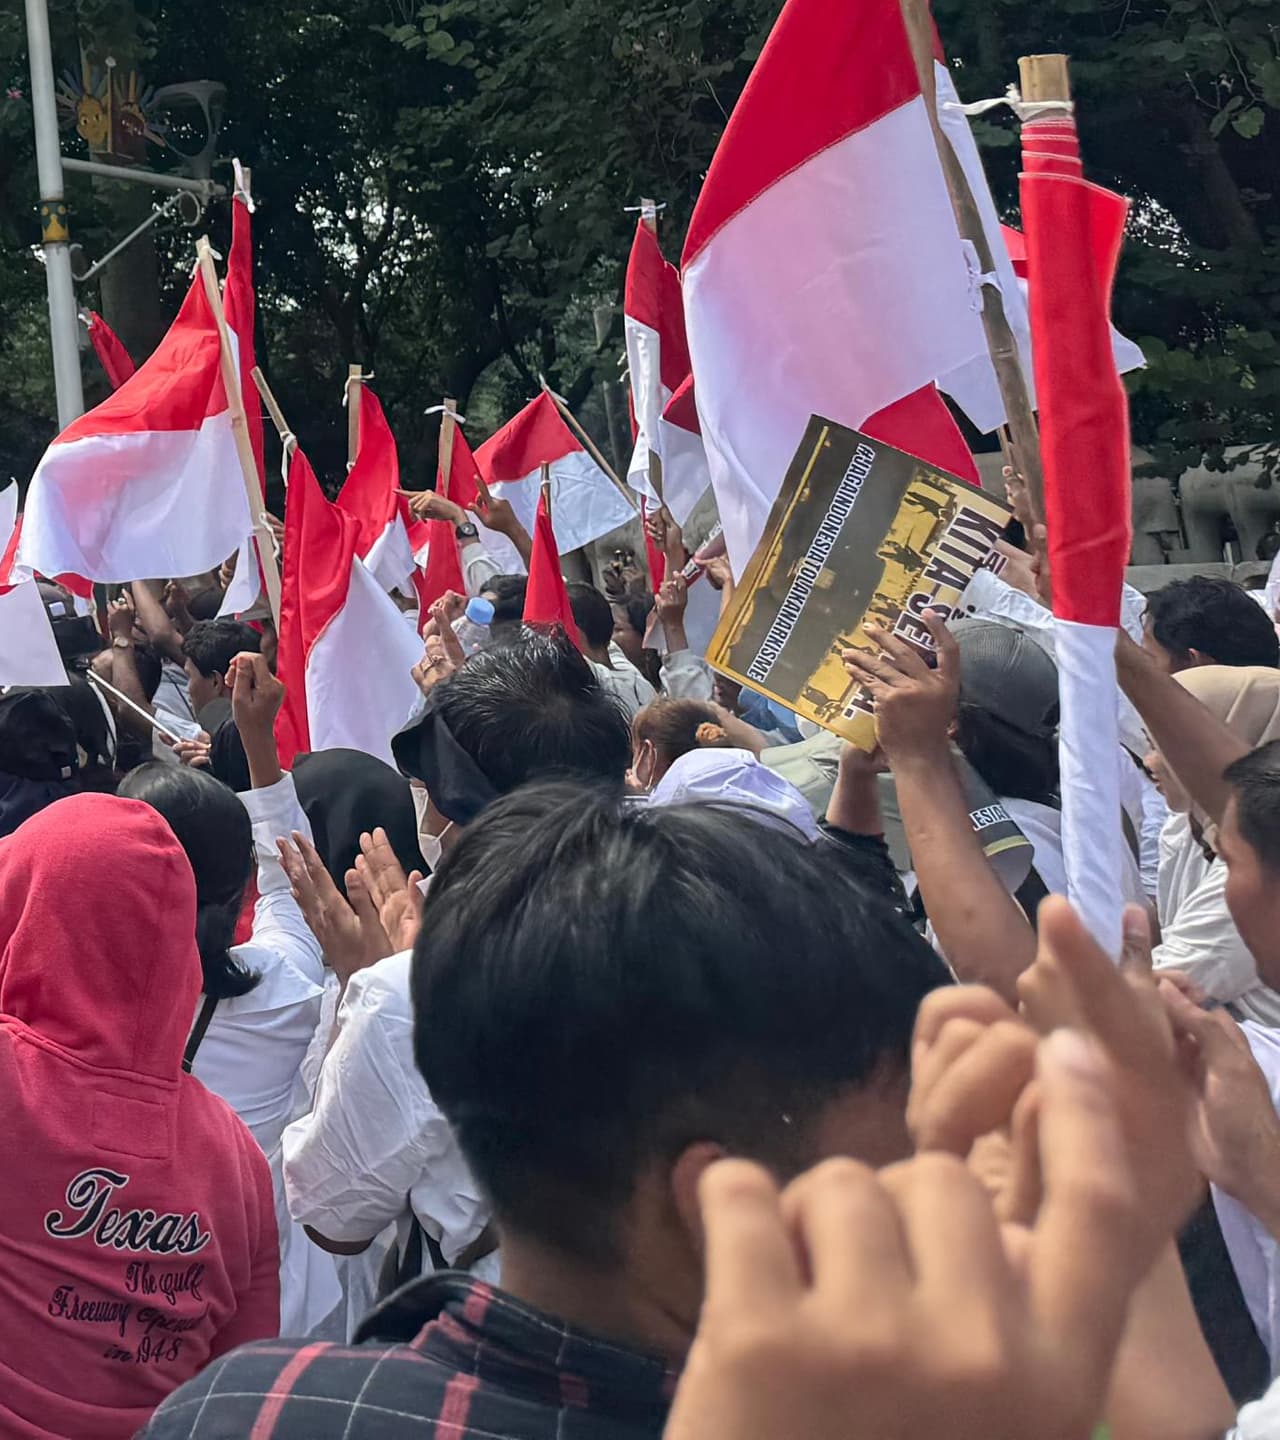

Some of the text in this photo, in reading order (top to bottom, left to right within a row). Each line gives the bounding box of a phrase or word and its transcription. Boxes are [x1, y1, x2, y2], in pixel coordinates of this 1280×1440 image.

[747, 443, 875, 683] #JAGAINDONESIATOLAKANARKISME
[923, 506, 1004, 592] KITA
[44, 1167, 211, 1256] Texas
[48, 1285, 130, 1338] Freeway
[125, 1262, 158, 1295] The
[136, 1335, 183, 1364] 1948
